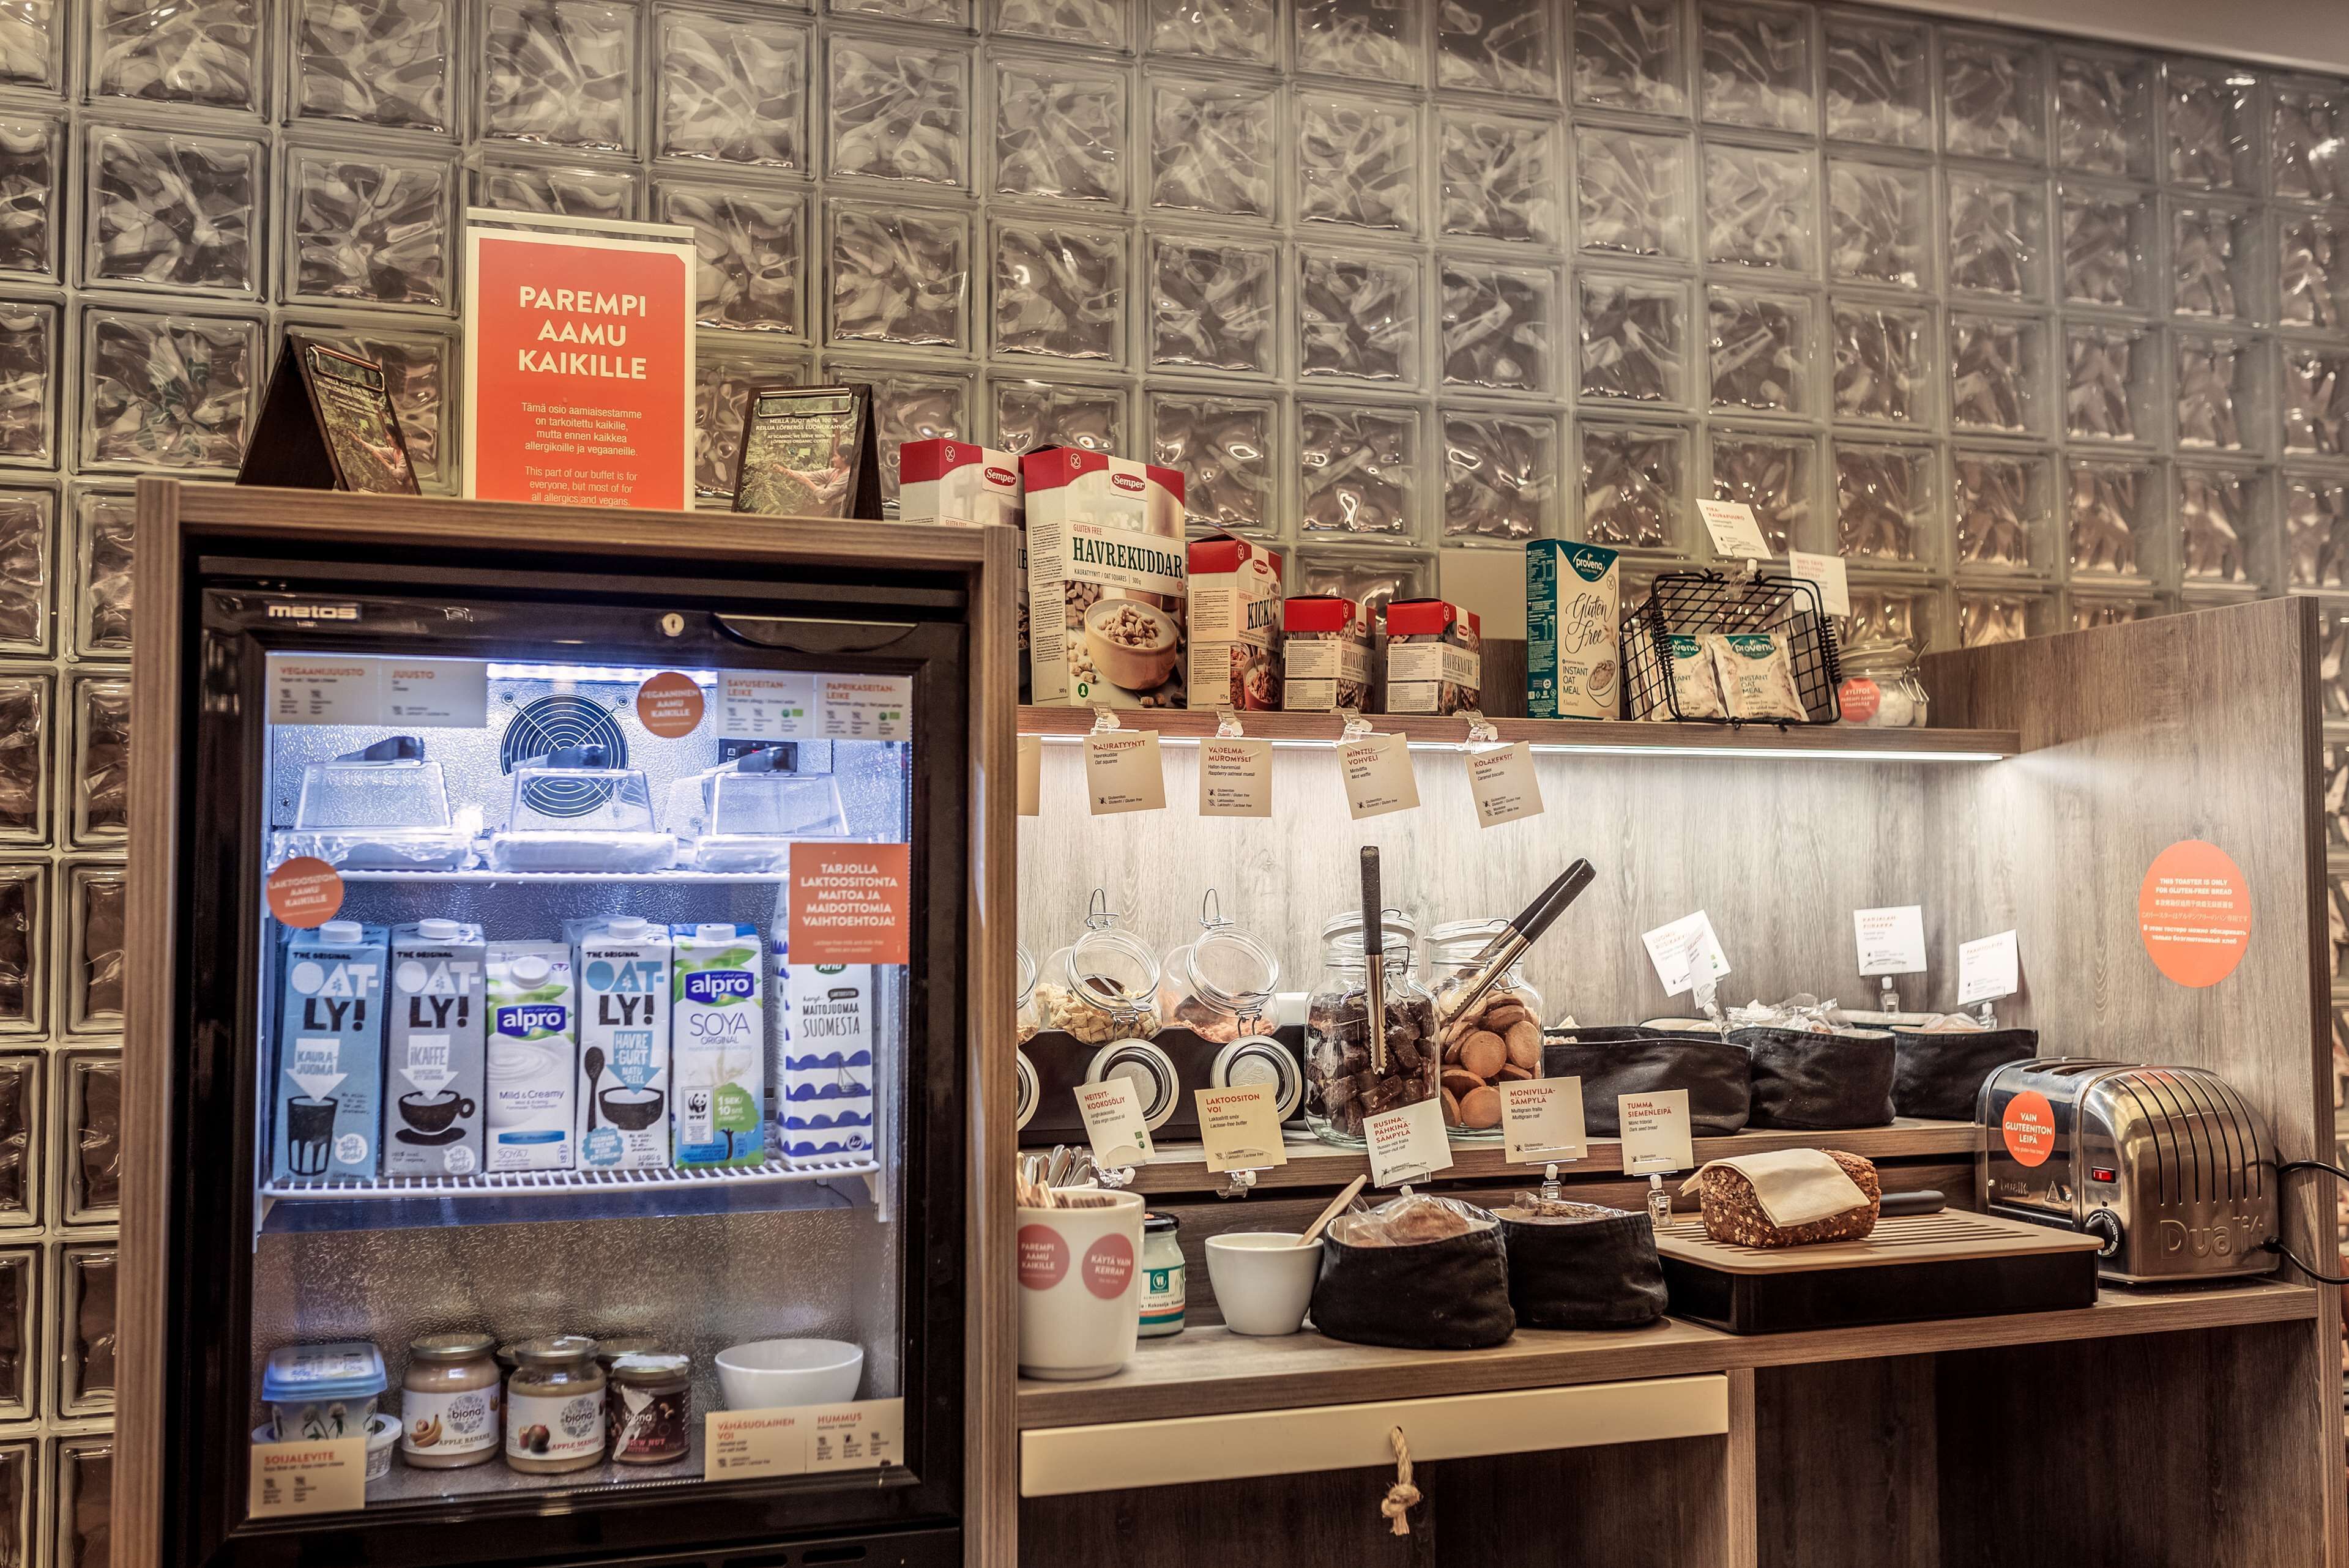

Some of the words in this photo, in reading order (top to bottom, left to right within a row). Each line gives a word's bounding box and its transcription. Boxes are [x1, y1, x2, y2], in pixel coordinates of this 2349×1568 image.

[519, 286, 646, 316] PAREMPI
[537, 320, 626, 346] AAMU
[519, 349, 647, 379] KAIKILLE
[522, 403, 546, 412] Tämä
[549, 405, 566, 414] osio
[569, 407, 641, 418] aamiaisestamme
[549, 418, 593, 428] tarkoitettu
[596, 420, 628, 431] kaikille,
[537, 430, 562, 439] mutta
[594, 433, 627, 443] kaikkea
[525, 442, 574, 453] allergikoille
[576, 444, 584, 455] ja
[587, 447, 638, 456] vegaaneille.
[525, 466, 542, 476] This
[545, 469, 561, 478] part
[564, 469, 572, 477] of
[591, 470, 614, 480] buffet
[627, 472, 637, 481] for
[987, 469, 1015, 483] Semper
[529, 481, 570, 491] everyone,
[573, 481, 586, 491] but
[611, 484, 619, 492] of
[622, 485, 633, 493] for
[1114, 475, 1145, 489] Semper
[532, 492, 541, 501] all
[545, 493, 578, 504] allergics
[581, 496, 596, 504] and
[599, 497, 630, 507] vegans.
[1073, 524, 1090, 533] GLUTEN
[1073, 537, 1183, 579] HAVREKUDDAR
[1576, 558, 1603, 570] provena
[268, 606, 357, 620] metos
[1248, 598, 1272, 630] KICK!
[1565, 620, 1606, 653] Free
[1563, 666, 1588, 676] INSTANT
[1563, 675, 1576, 684] OAT
[1563, 685, 1580, 695] MEAL
[1093, 740, 1145, 750] KAURATYYNYT
[1347, 748, 1376, 758] MINTTU-
[1348, 755, 1378, 765] VOHVELI
[821, 864, 879, 874] TARJOLLA
[800, 877, 898, 887] LAKTOOSITONTA
[818, 890, 864, 900] MAITOA
[866, 891, 880, 900] JA
[806, 904, 892, 913] MAIDOTTOMIA
[803, 916, 896, 926] VAIHTOEHTOJA!
[291, 962, 379, 997] OAT-
[396, 960, 481, 994] OAT-
[586, 960, 664, 993] OAT-
[691, 974, 749, 998] alpro
[303, 998, 365, 1031] LY!
[409, 995, 469, 1028] LY!
[598, 994, 654, 1026] LY!
[803, 1003, 859, 1015] MAITOJUOMAA
[502, 1008, 562, 1032] alpro
[690, 1013, 751, 1036] SOYA
[803, 1016, 860, 1038] SUOMESTA
[616, 1033, 649, 1050] HAVRE
[701, 1036, 739, 1045] ORIGINAL
[297, 1051, 337, 1063] KAURA-
[527, 1090, 565, 1099] Creamy
[1084, 1091, 1109, 1101] NEITSYT-
[1510, 1088, 1555, 1097] MONIVILJA-
[1087, 1096, 1125, 1110] KOOKOSÖLJY
[1206, 1094, 1260, 1105] LAKTOOSITON
[1511, 1095, 1547, 1105] SÄMPYLÄ
[1628, 1106, 1672, 1117] SIEMENLEIPÄ
[2020, 1113, 2037, 1122] VAIN
[1374, 1117, 1404, 1129] RUSINA-
[1375, 1121, 1410, 1136] PÄHKINÄ-
[2005, 1121, 2052, 1135] GLUTEENITON
[1376, 1128, 1411, 1143] SÄMPYLÄ
[2019, 1134, 2038, 1145] LEIPÄ
[1022, 1261, 1055, 1270] KAIKILLE
[1091, 1254, 1115, 1265] KÄYTÄ
[1117, 1257, 1131, 1266] VAIN
[1095, 1265, 1125, 1276] KERRAN
[717, 1418, 795, 1431] VÄHÄSUOLAINEN
[817, 1413, 862, 1424] HUMMUS
[577, 1437, 600, 1447] MANGO
[648, 1438, 666, 1446] NUT
[717, 1432, 734, 1440] VOI
[264, 1452, 334, 1465] SOIJALEVITE
